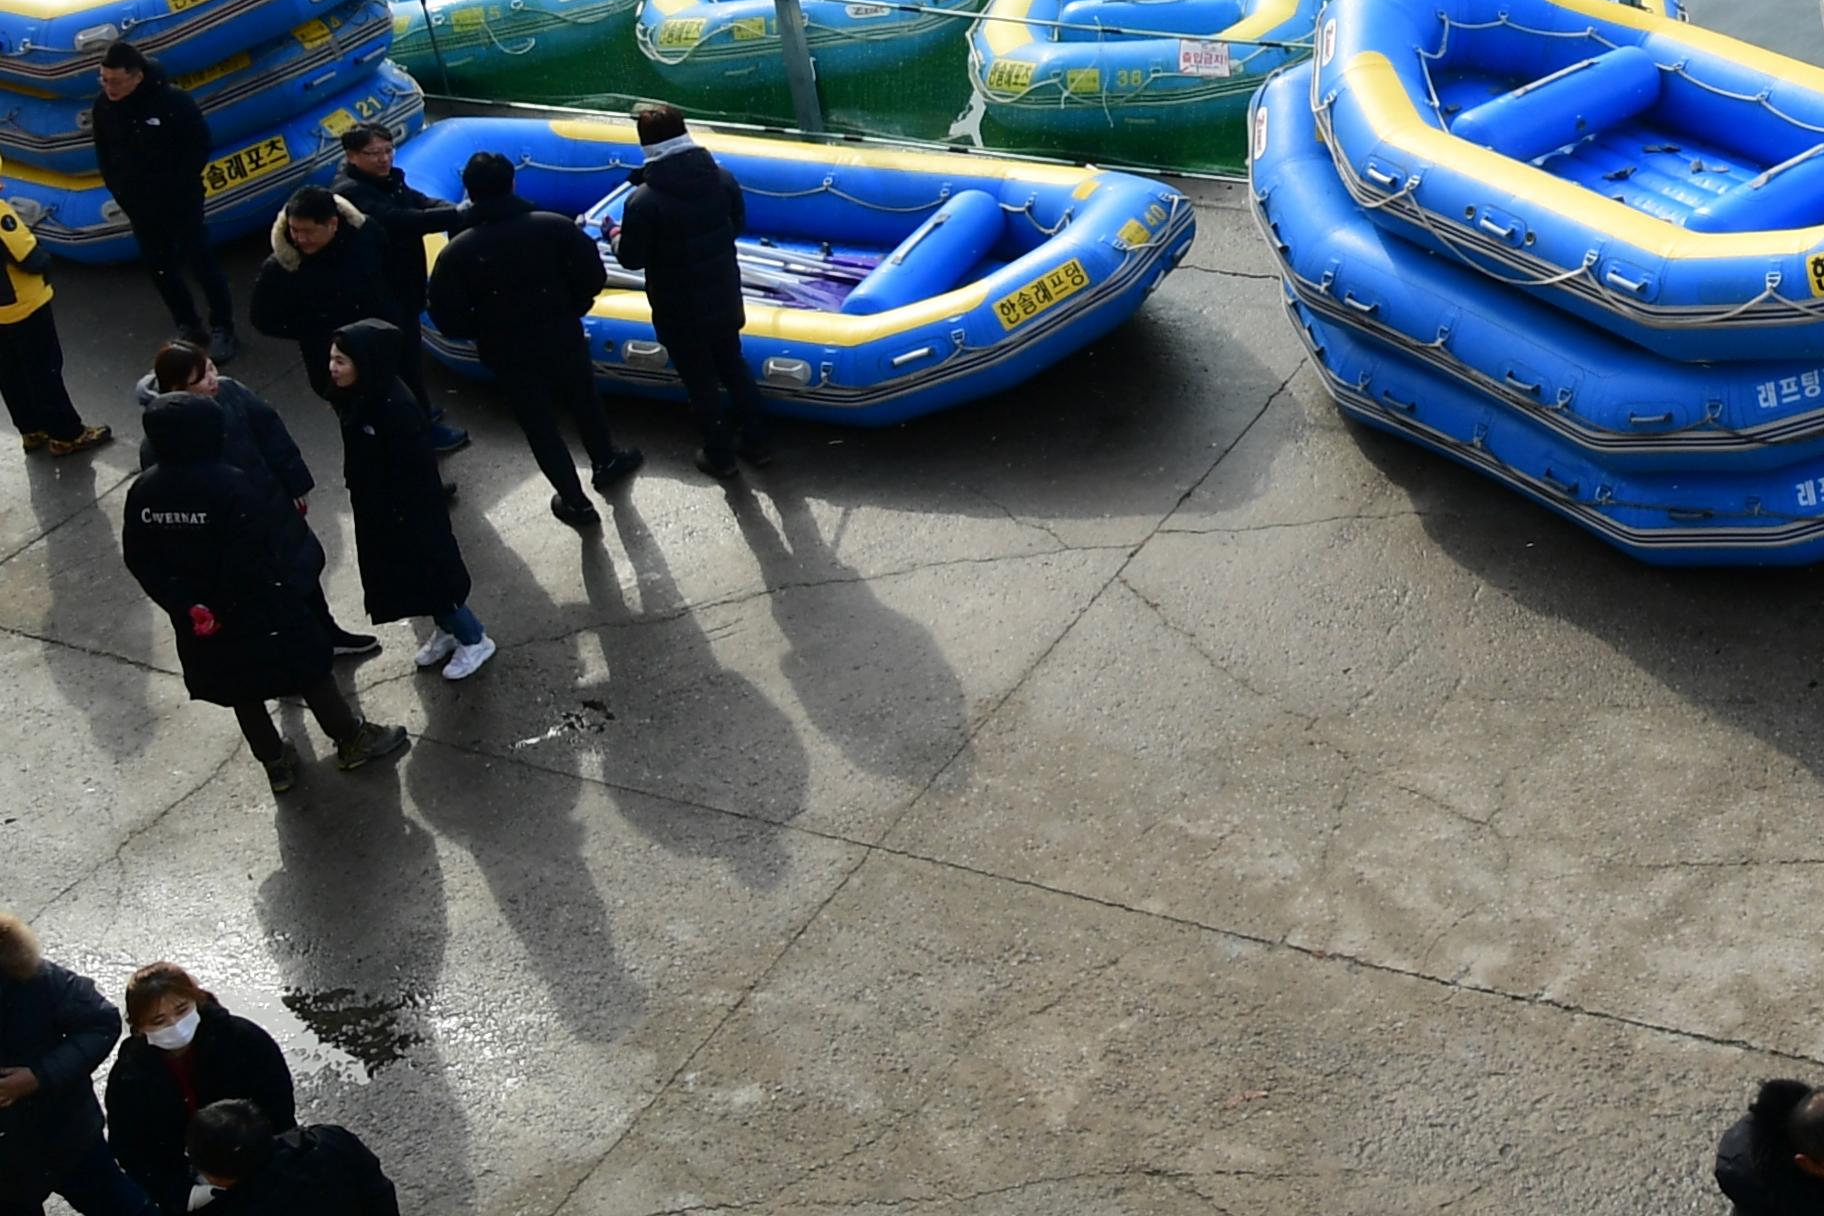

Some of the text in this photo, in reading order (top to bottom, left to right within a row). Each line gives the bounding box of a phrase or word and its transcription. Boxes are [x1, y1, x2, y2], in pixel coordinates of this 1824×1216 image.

[1181, 50, 1229, 67] 출입금지!
[356, 96, 383, 118] 21
[203, 137, 288, 191] 솔레포츠
